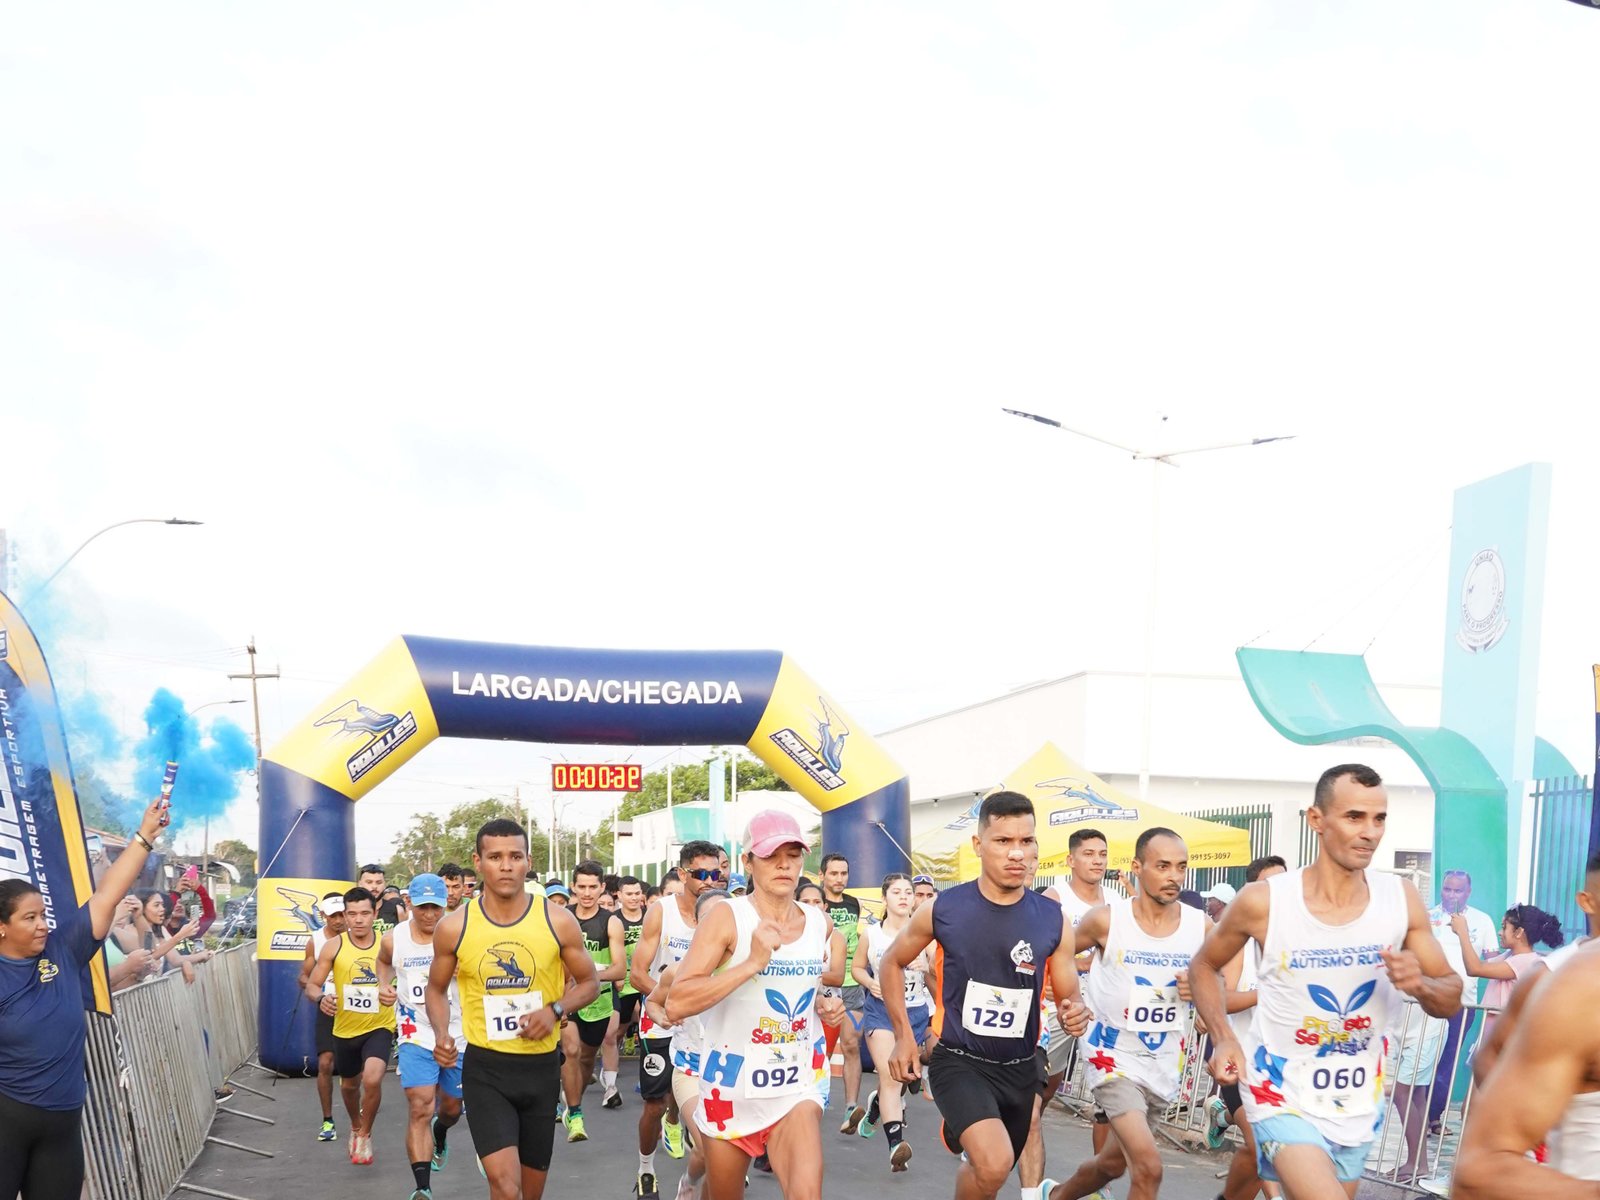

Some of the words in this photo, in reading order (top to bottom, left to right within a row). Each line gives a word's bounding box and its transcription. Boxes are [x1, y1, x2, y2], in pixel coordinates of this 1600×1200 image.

[451, 671, 743, 705] LARGADA/CHEGADA
[348, 713, 416, 777] AQUILLES
[775, 729, 845, 789] AQUILLES
[1051, 809, 1137, 822] AQUILLES
[21, 799, 57, 934] ONOMETRAGEM
[1038, 861, 1055, 870] GEM
[668, 940, 688, 950] AUTIS
[1300, 948, 1340, 957] CORRIDA
[1123, 955, 1169, 966] AUTISMO
[1171, 958, 1190, 968] RUN
[1289, 955, 1354, 969] AUTISMO
[486, 976, 529, 987] AQUILLES
[412, 985, 427, 997] 0
[347, 997, 372, 1008] 120
[971, 1007, 1015, 1029] 129
[1134, 1006, 1176, 1023] 066
[492, 1015, 519, 1032] 16
[752, 1066, 799, 1088] 092
[1312, 1067, 1366, 1090] 060
